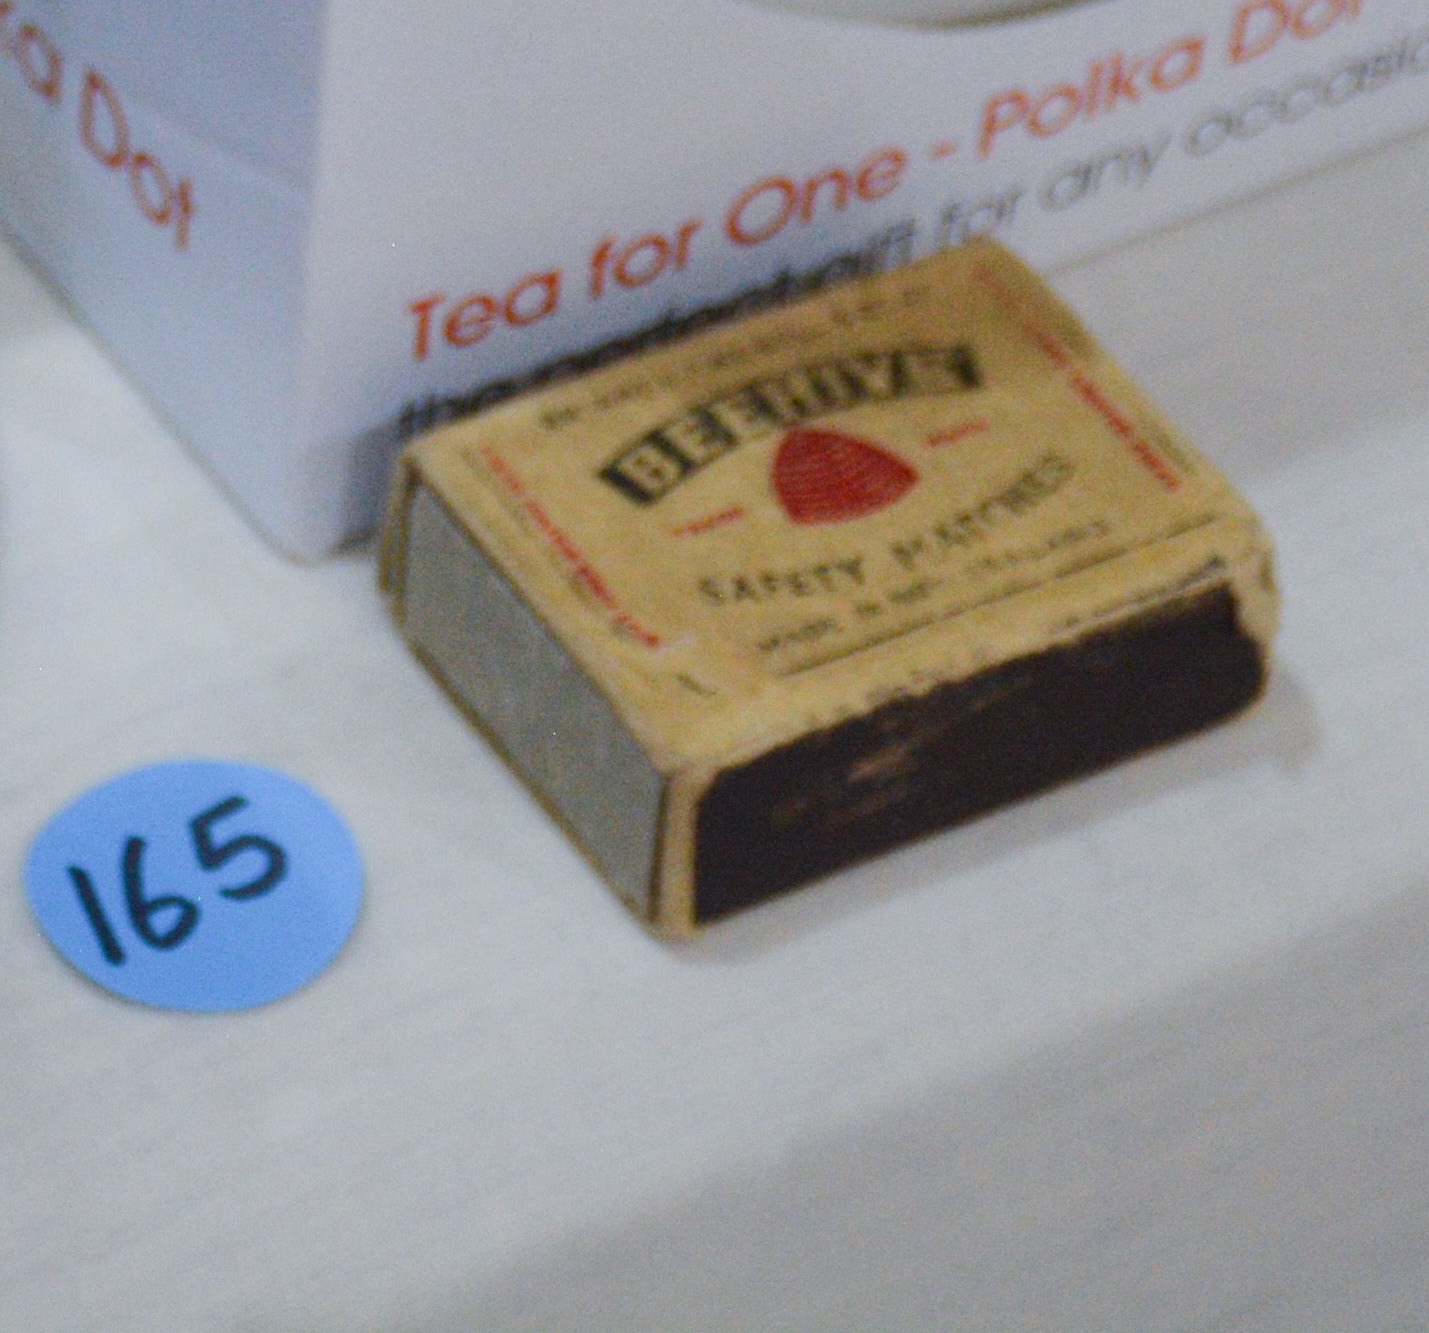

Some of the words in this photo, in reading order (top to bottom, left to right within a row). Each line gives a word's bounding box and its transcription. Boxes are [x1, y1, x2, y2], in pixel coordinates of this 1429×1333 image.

[79, 63, 195, 252] Dot
[406, 267, 563, 363] Tea
[585, 218, 703, 301] for
[725, 147, 907, 246] One
[975, 33, 1206, 161] Polka
[1031, 131, 1164, 210] any
[696, 553, 866, 607] SAFETY
[67, 794, 289, 967] 165
